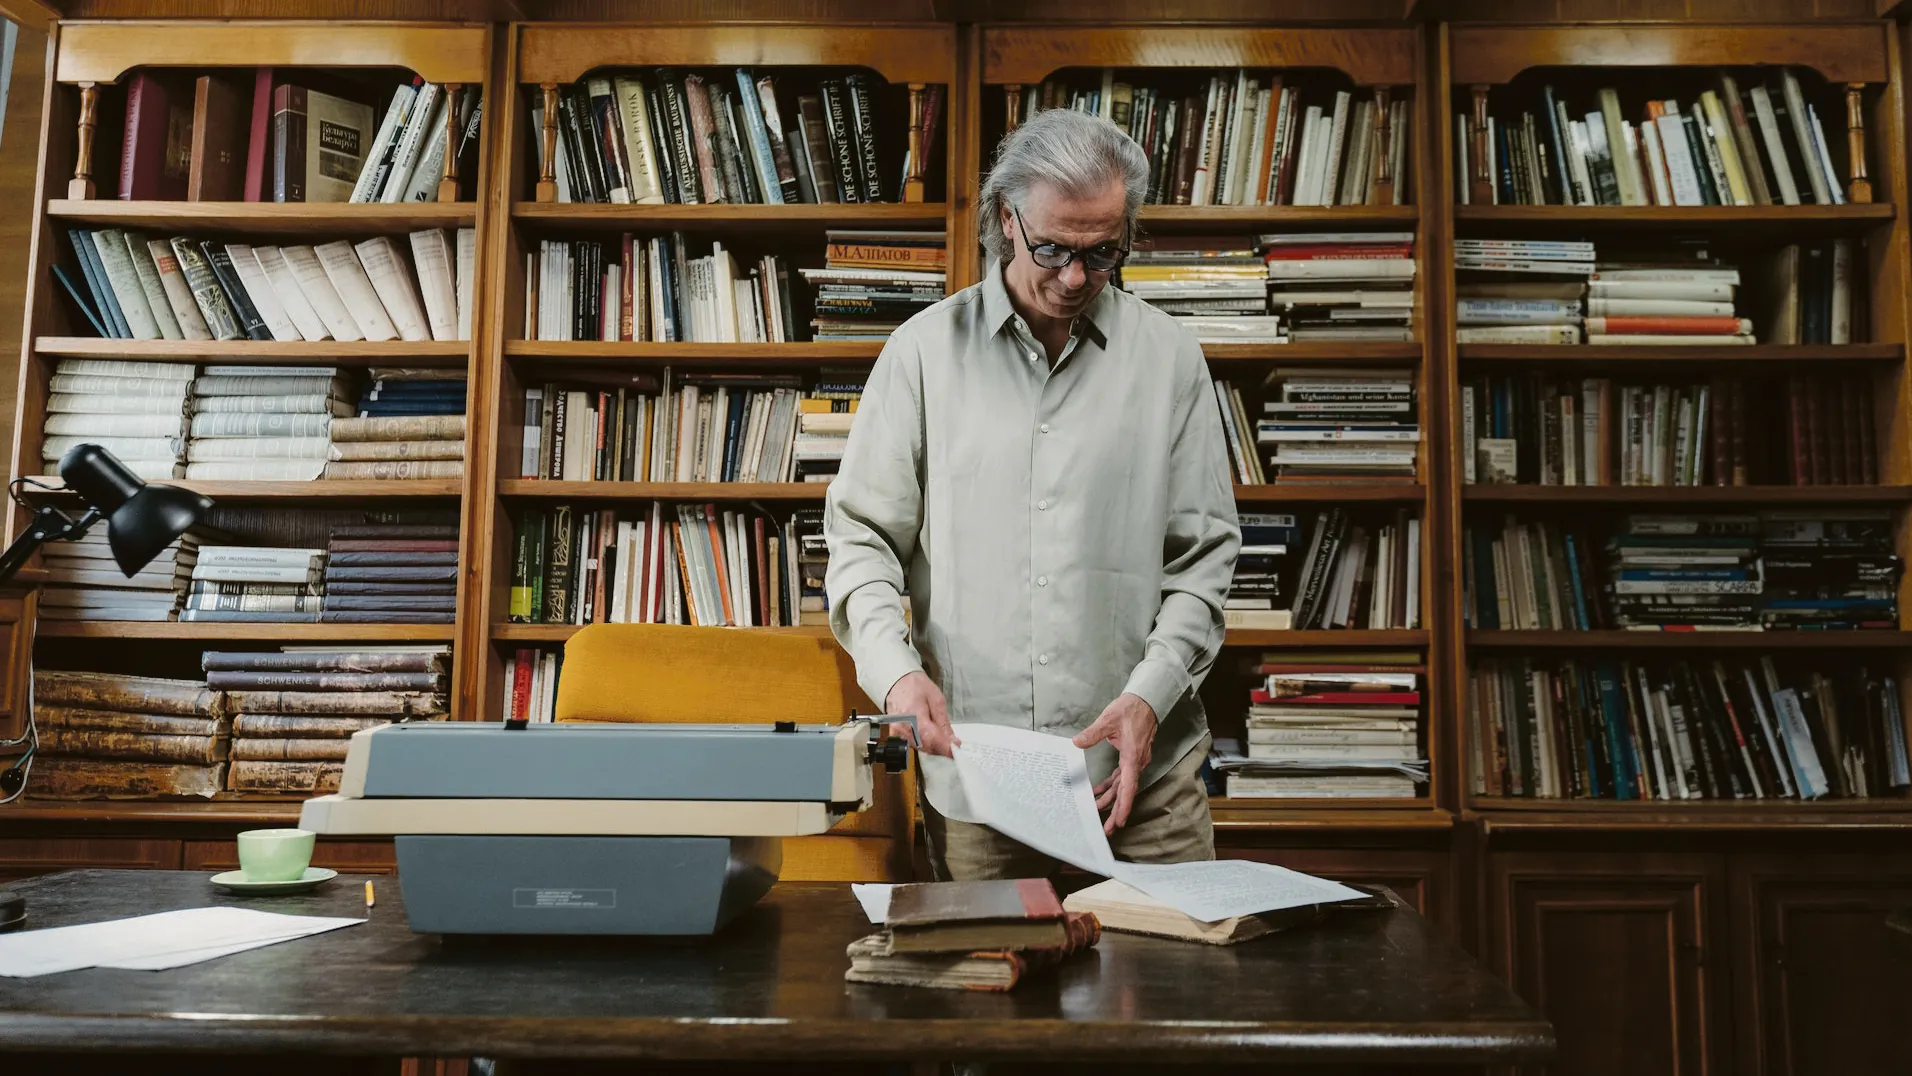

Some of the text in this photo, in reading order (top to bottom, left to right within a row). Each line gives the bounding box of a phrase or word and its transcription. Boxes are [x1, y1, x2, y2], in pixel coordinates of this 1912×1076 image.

[628, 93, 644, 135] BAROK
[830, 92, 845, 136] SCHRIFT
[858, 89, 871, 132] SCHRIFT
[666, 83, 692, 191] ALTRUSSISCHE BAUKUNST
[845, 179, 856, 201] DIE
[870, 176, 881, 197] DIE
[1300, 393, 1347, 402] Afghanistan
[1348, 393, 1364, 401] und
[1387, 393, 1411, 401] Kunst
[257, 676, 312, 686] SCHWENKE
